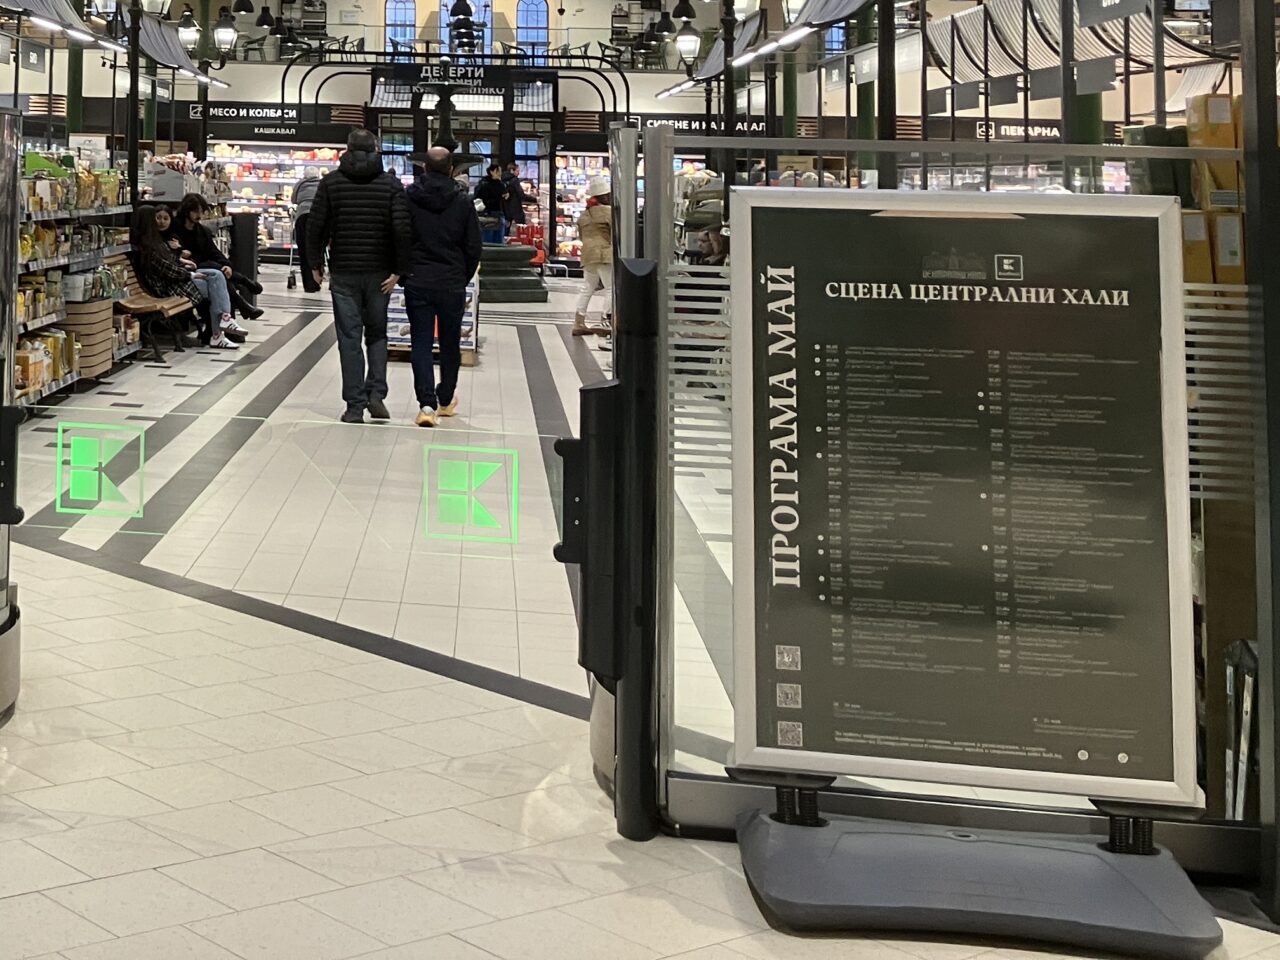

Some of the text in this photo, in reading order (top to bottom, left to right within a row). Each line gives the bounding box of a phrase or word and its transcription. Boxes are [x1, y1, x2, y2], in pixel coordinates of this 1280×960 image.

[209, 107, 297, 118] МЕСО И КОЛБАСИ
[254, 127, 296, 135] КАШКАВАЛ
[691, 121, 700, 130] И
[1000, 125, 1061, 138] ПЕКАРНА
[824, 282, 1130, 307] СЦЕНА ЦЕНТРАЛНИ ХАЛИ
[760, 264, 801, 589] ПРОГРАМА МАЙ
